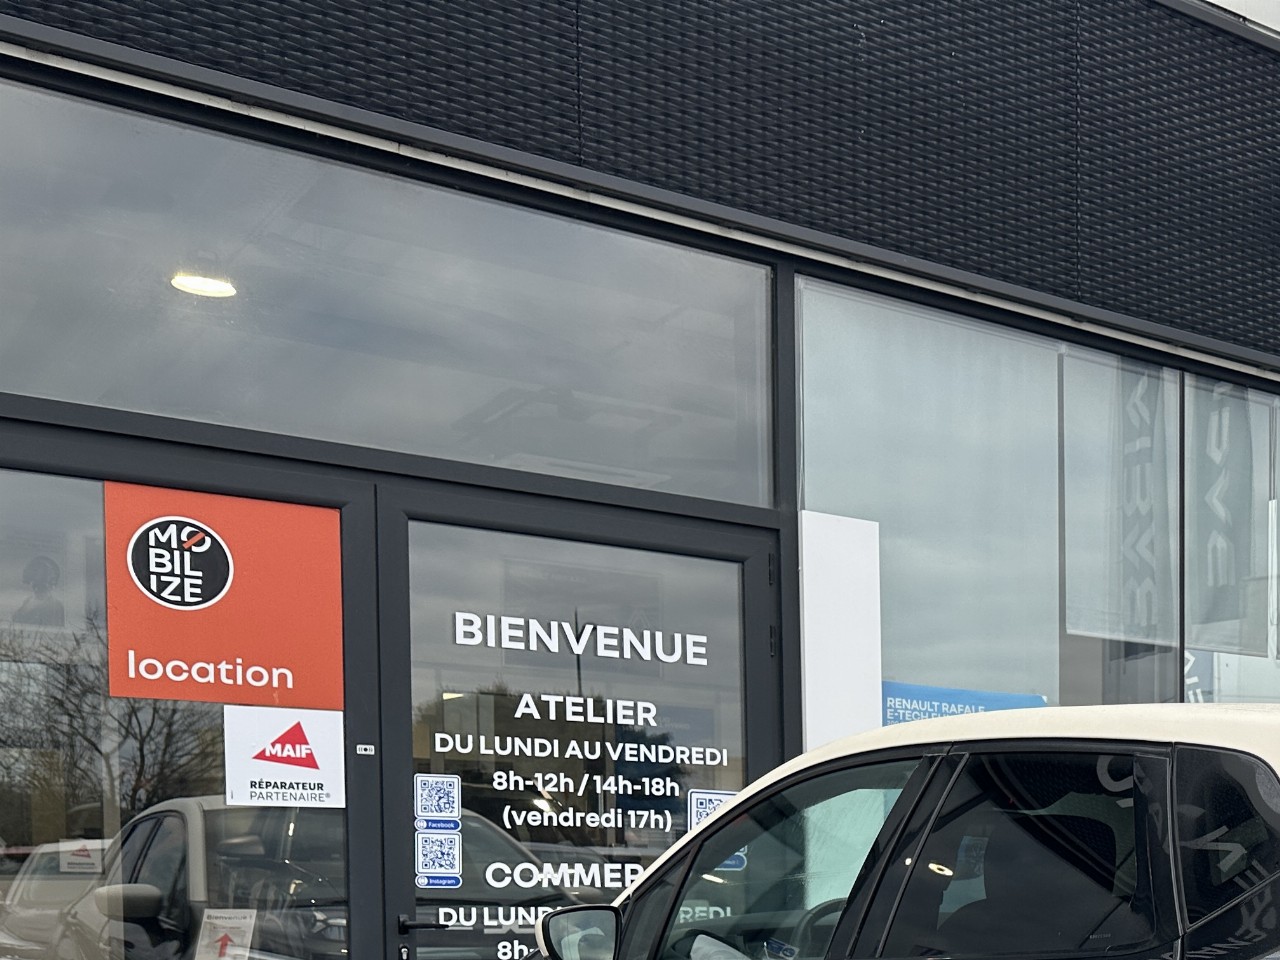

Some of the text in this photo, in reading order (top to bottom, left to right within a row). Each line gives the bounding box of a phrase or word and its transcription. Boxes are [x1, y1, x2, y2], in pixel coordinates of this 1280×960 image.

[454, 611, 708, 666] BIENVENUE
[127, 649, 294, 689] location
[514, 693, 658, 727] ATELIER
[886, 697, 940, 713] RENAULT
[264, 743, 313, 759] MAIF
[434, 733, 728, 766] DU LUNDI AU VENDREDI
[249, 778, 324, 791] RÉPARATEUR
[492, 771, 575, 794] 8h-12h
[592, 775, 680, 797] 14h-18h
[502, 805, 673, 833] (vendredi 17h)
[429, 878, 456, 886] Instagram
[485, 862, 644, 889] COMMER
[438, 907, 477, 927] DU
[496, 940, 535, 960] 8h-
